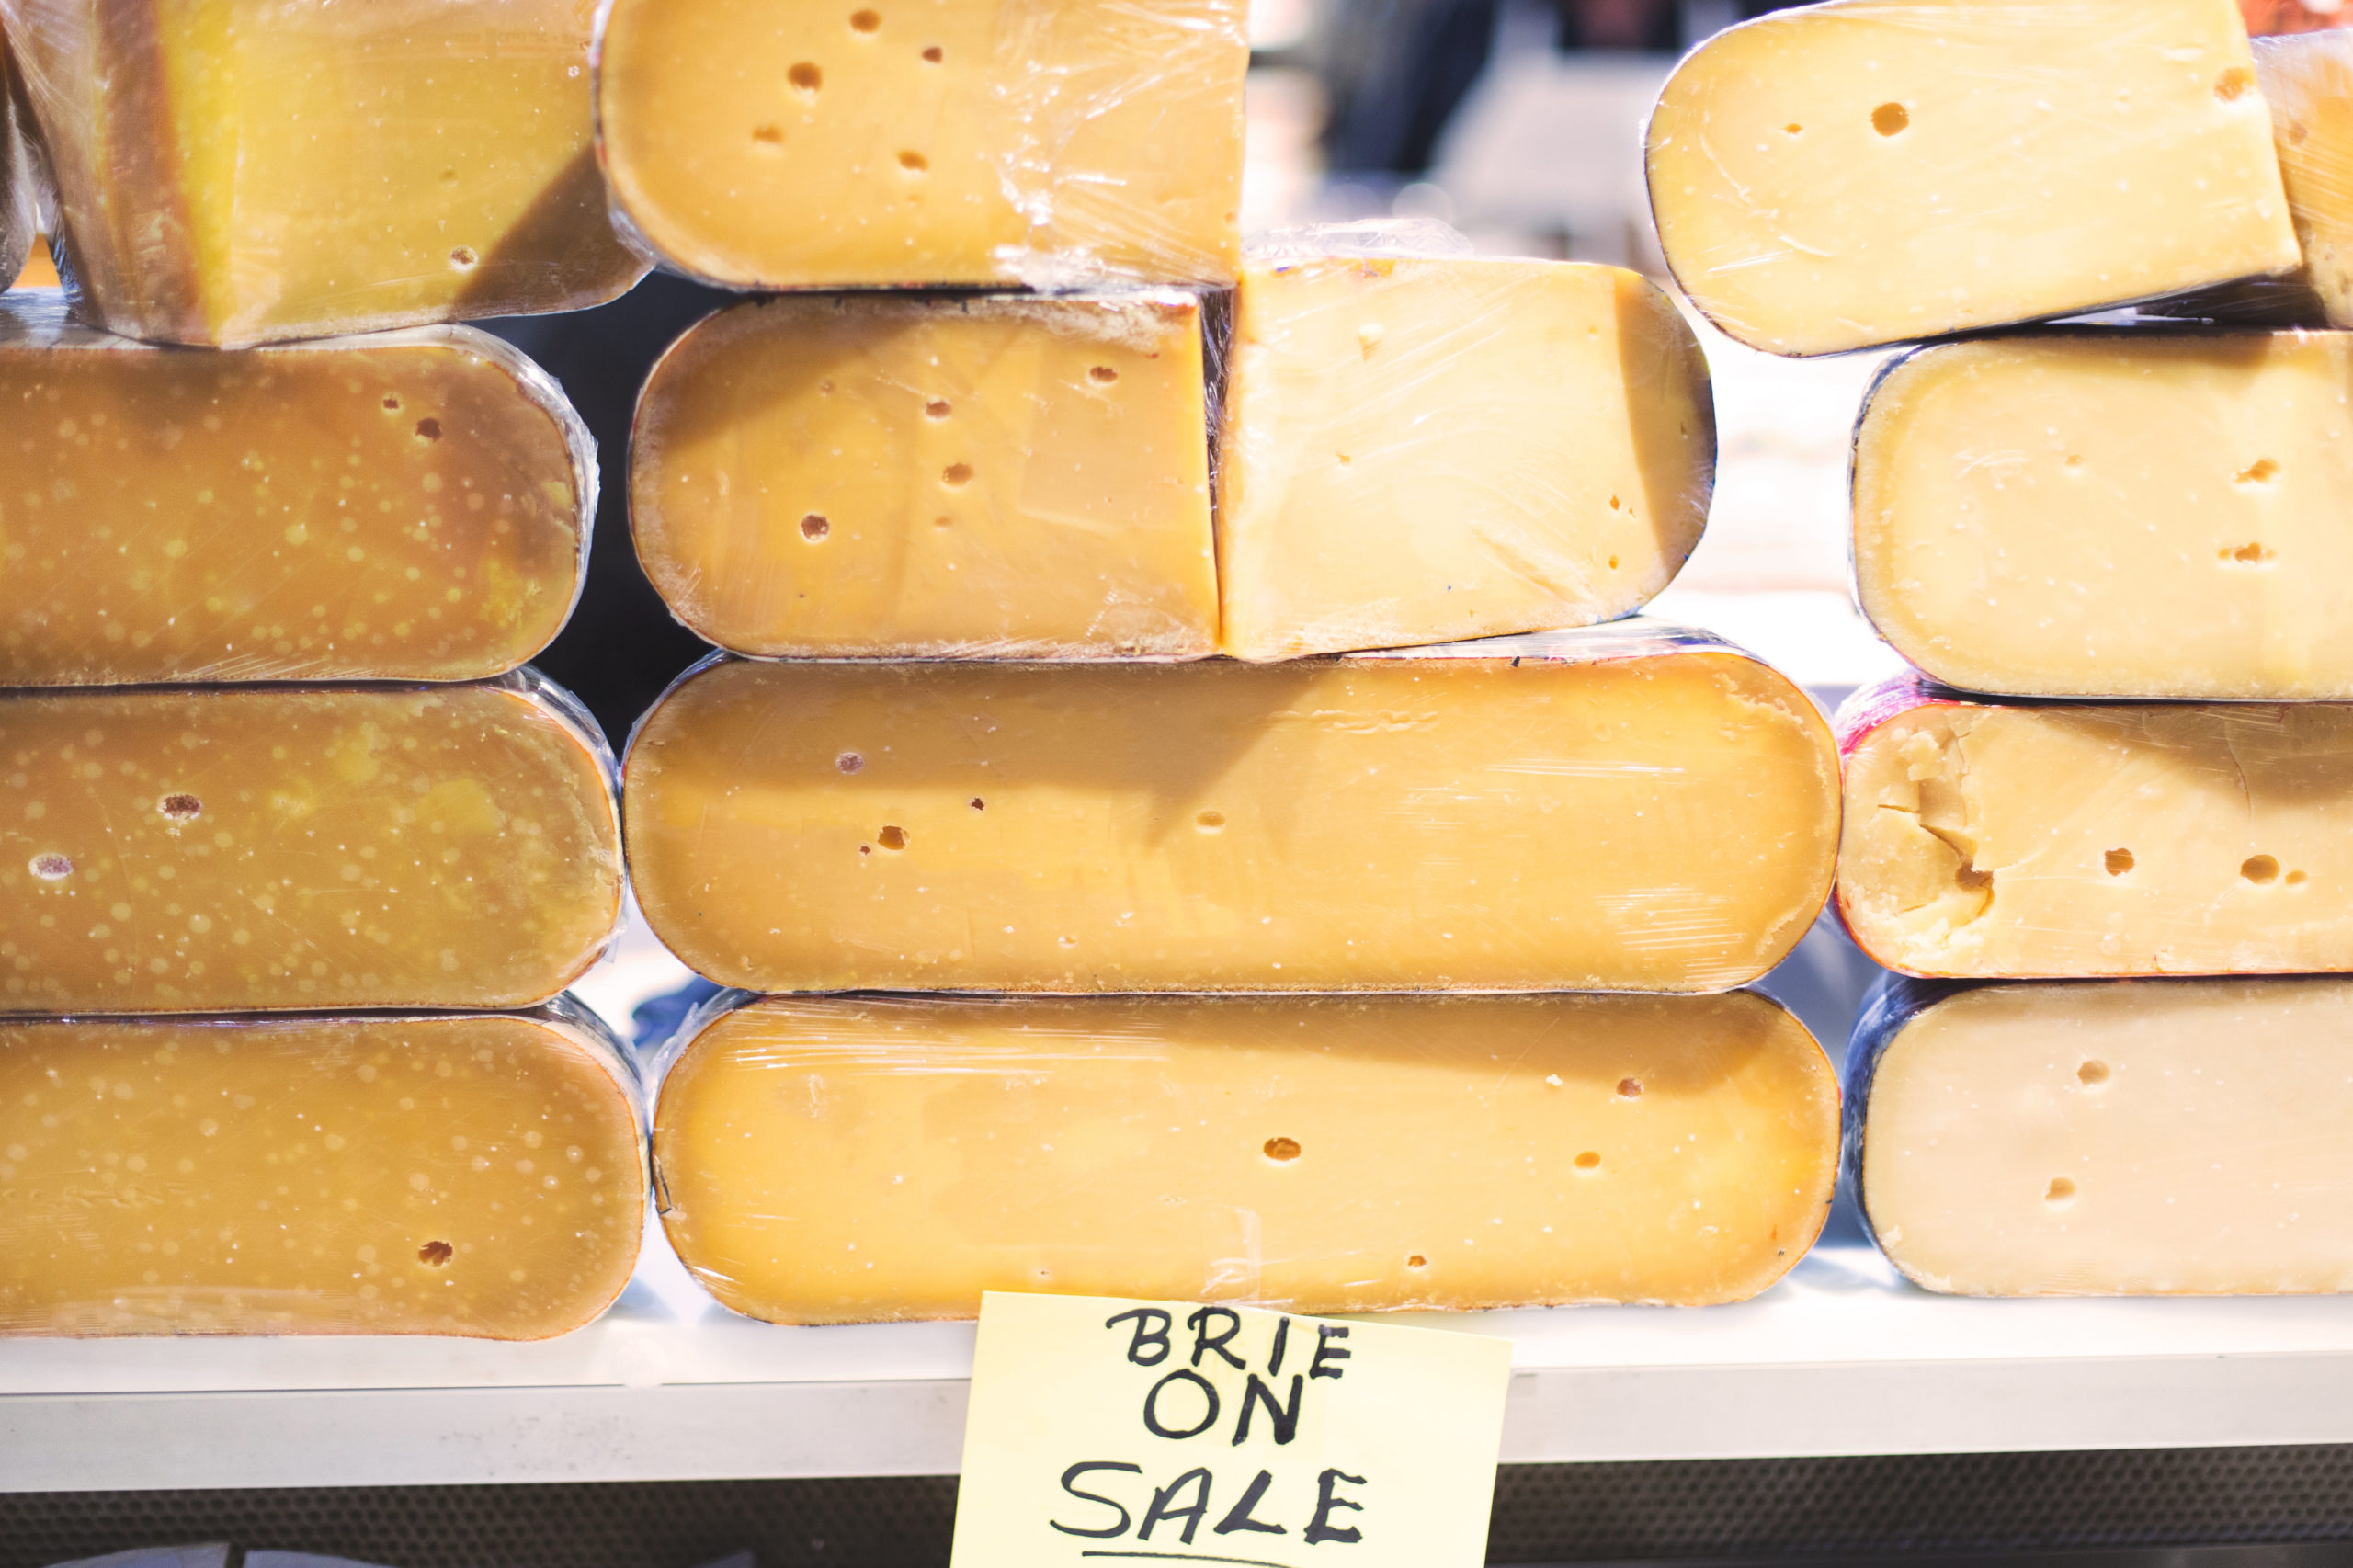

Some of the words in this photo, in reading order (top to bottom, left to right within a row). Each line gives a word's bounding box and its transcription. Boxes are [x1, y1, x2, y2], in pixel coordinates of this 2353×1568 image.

[1106, 1306, 1352, 1380] BRIE
[1143, 1368, 1303, 1447] ON
[1049, 1461, 1368, 1546] SALE
